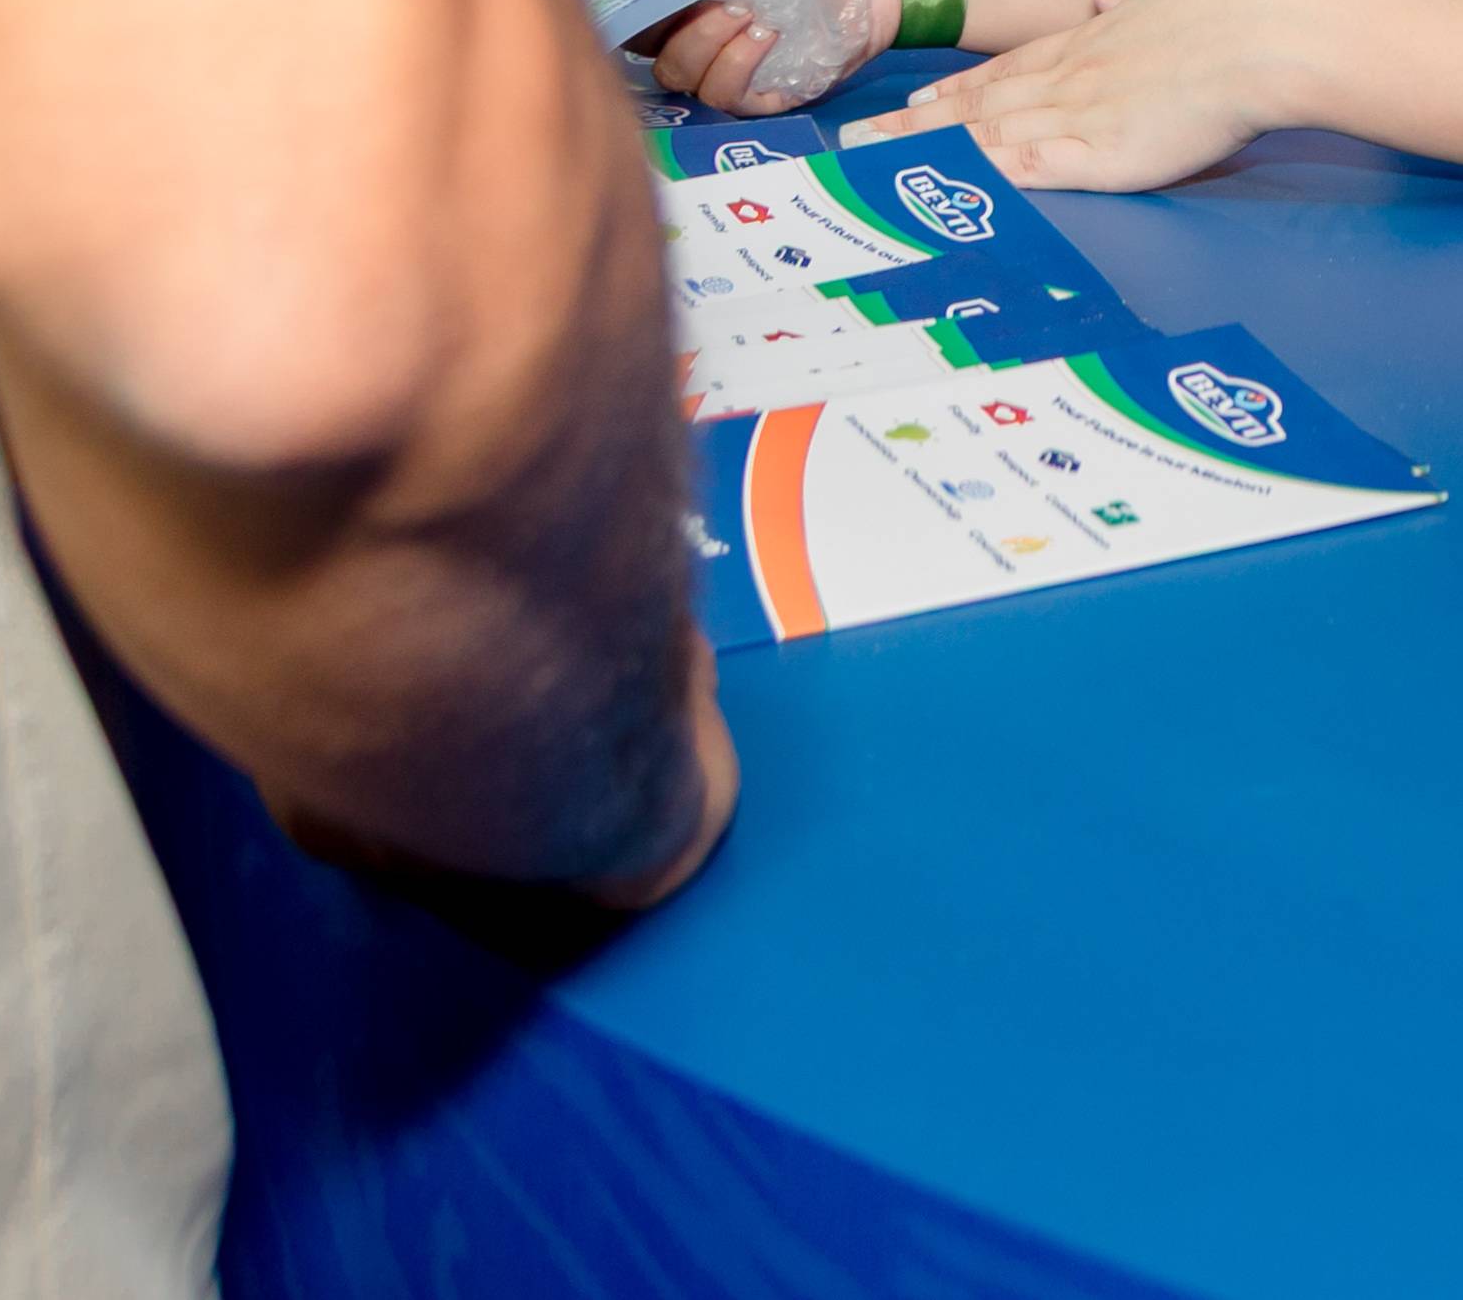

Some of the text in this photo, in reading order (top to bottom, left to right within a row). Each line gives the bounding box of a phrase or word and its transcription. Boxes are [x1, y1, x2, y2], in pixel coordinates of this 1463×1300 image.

[697, 202, 729, 234] Family
[790, 194, 822, 219] Your
[818, 217, 865, 246] Future
[877, 251, 906, 265] our
[906, 173, 979, 236] BEYTI
[1051, 395, 1087, 425] Your
[1086, 418, 1141, 450] Future
[1182, 372, 1268, 440] BEYTI
